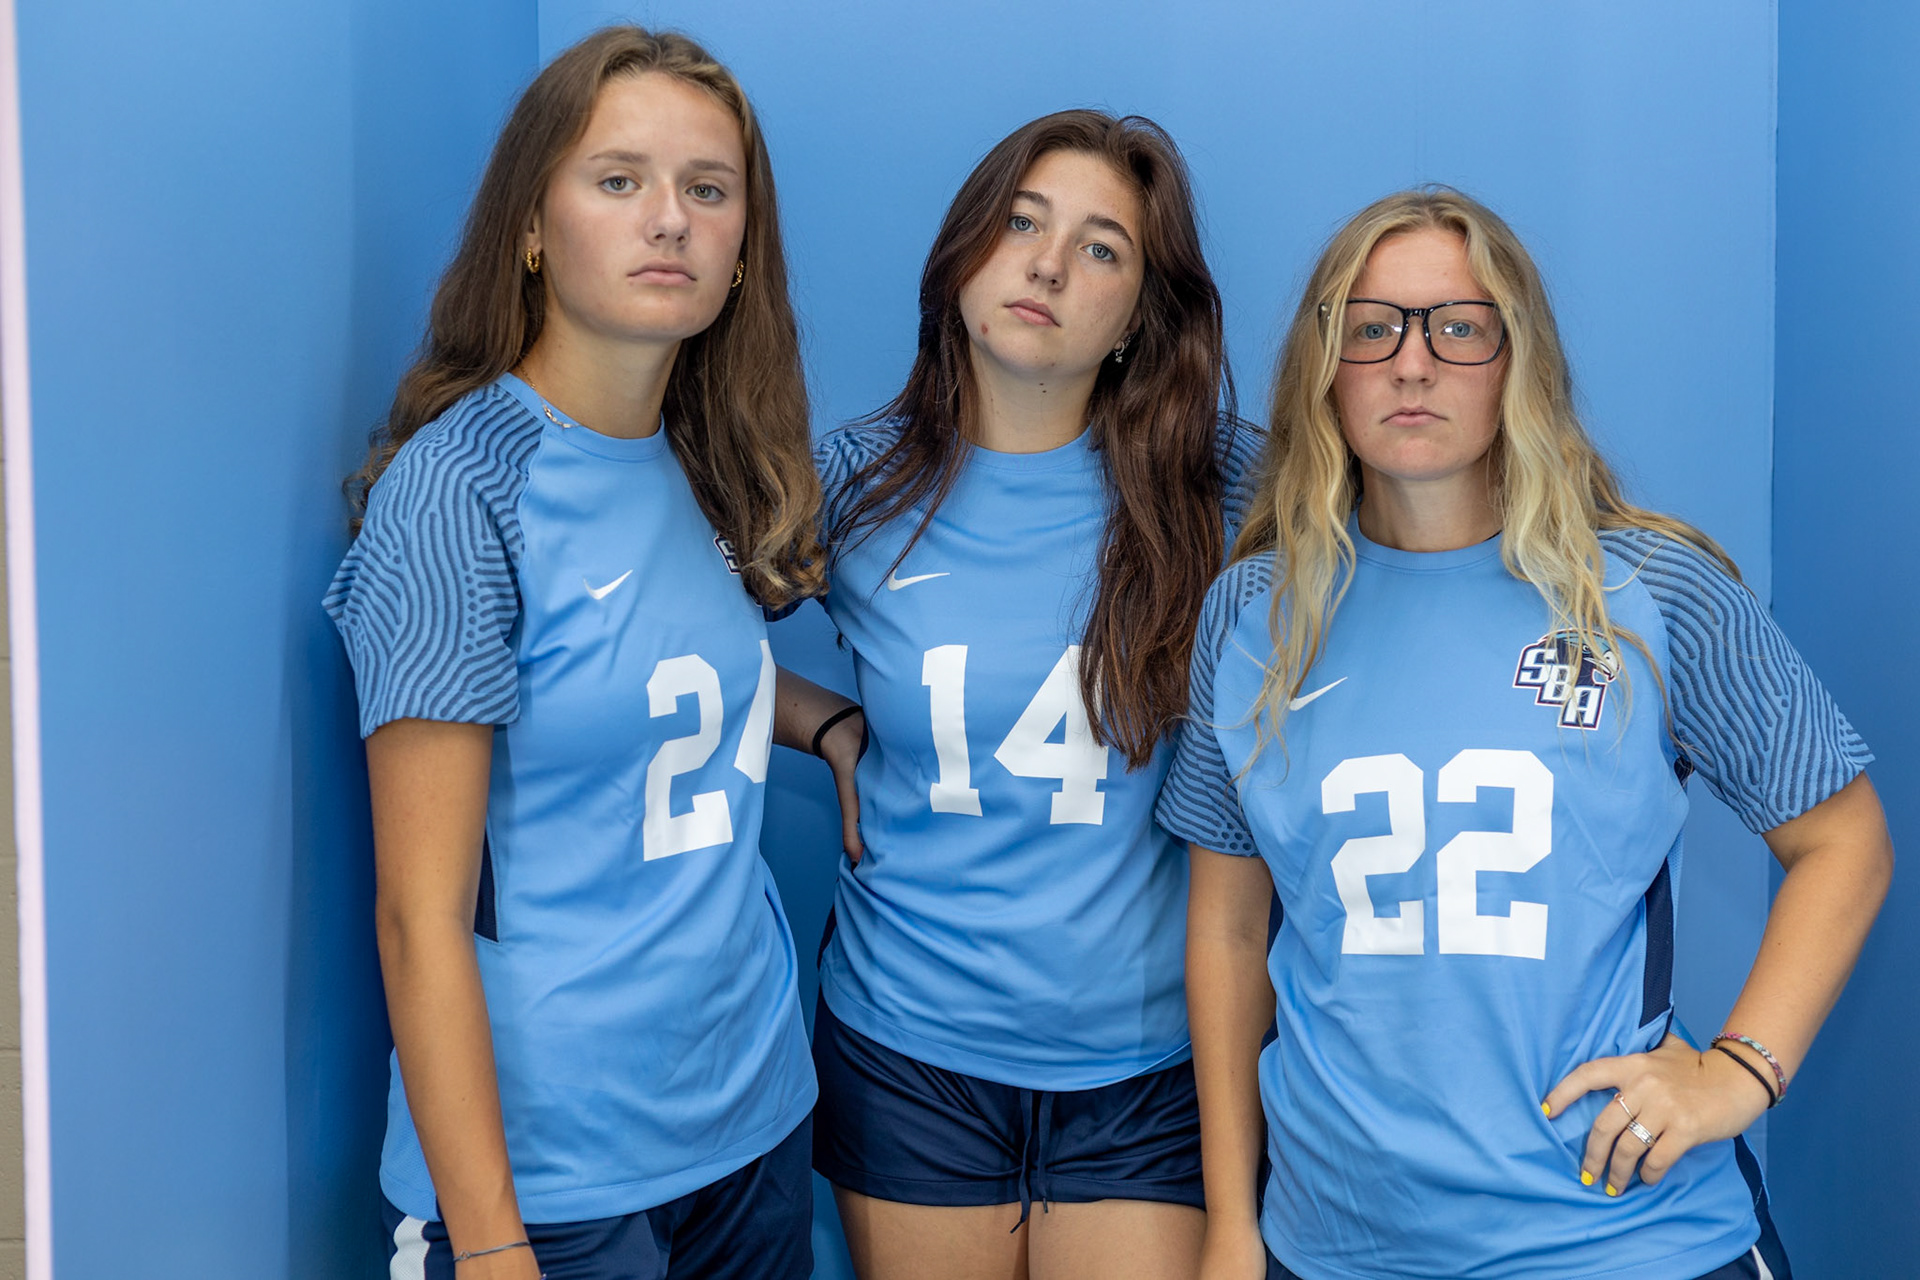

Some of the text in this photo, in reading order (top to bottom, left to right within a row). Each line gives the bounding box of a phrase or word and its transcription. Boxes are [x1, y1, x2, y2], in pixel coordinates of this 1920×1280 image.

[921, 644, 1109, 825] 14
[1517, 647, 1602, 727] SBA
[1321, 748, 1554, 960] 22
